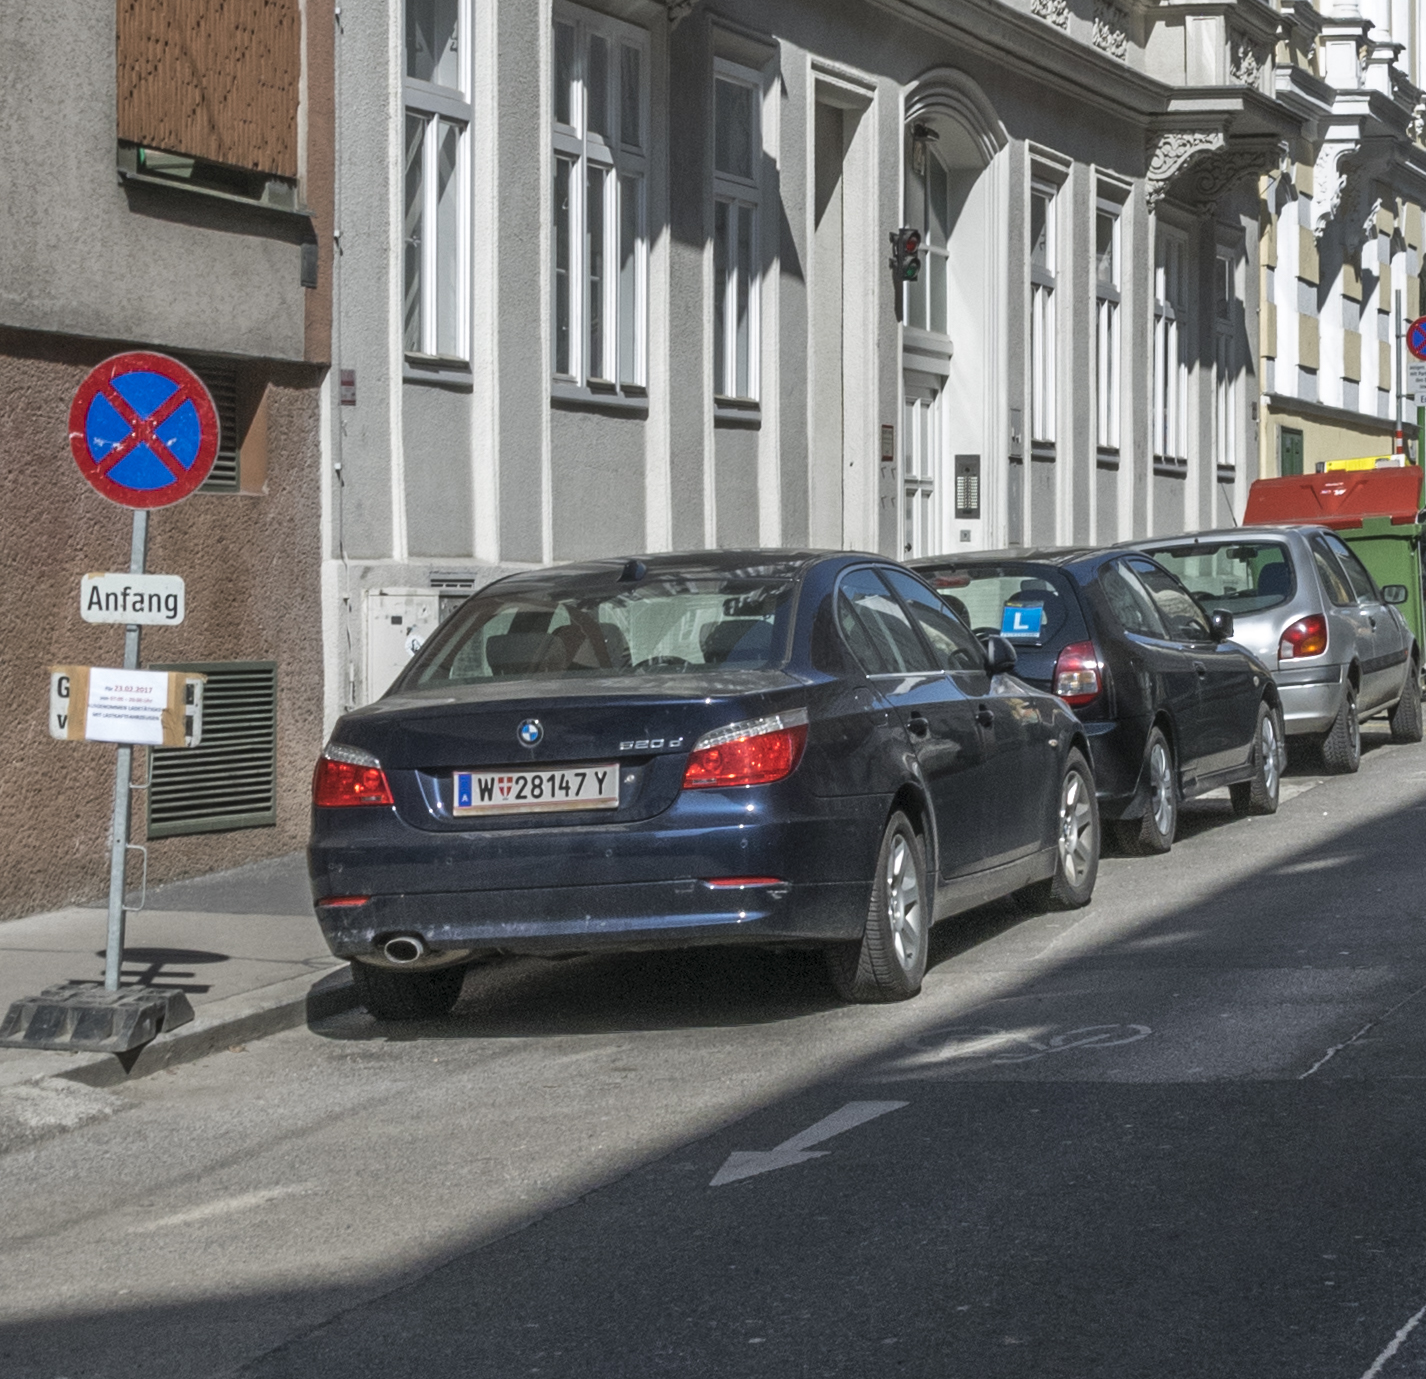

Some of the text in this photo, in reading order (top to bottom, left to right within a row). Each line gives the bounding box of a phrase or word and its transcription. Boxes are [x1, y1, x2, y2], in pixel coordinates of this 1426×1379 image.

[87, 585, 178, 620] Anfang
[1013, 612, 1029, 630] L
[478, 777, 495, 802] W
[515, 772, 587, 800] 28147
[594, 771, 608, 796] Y
